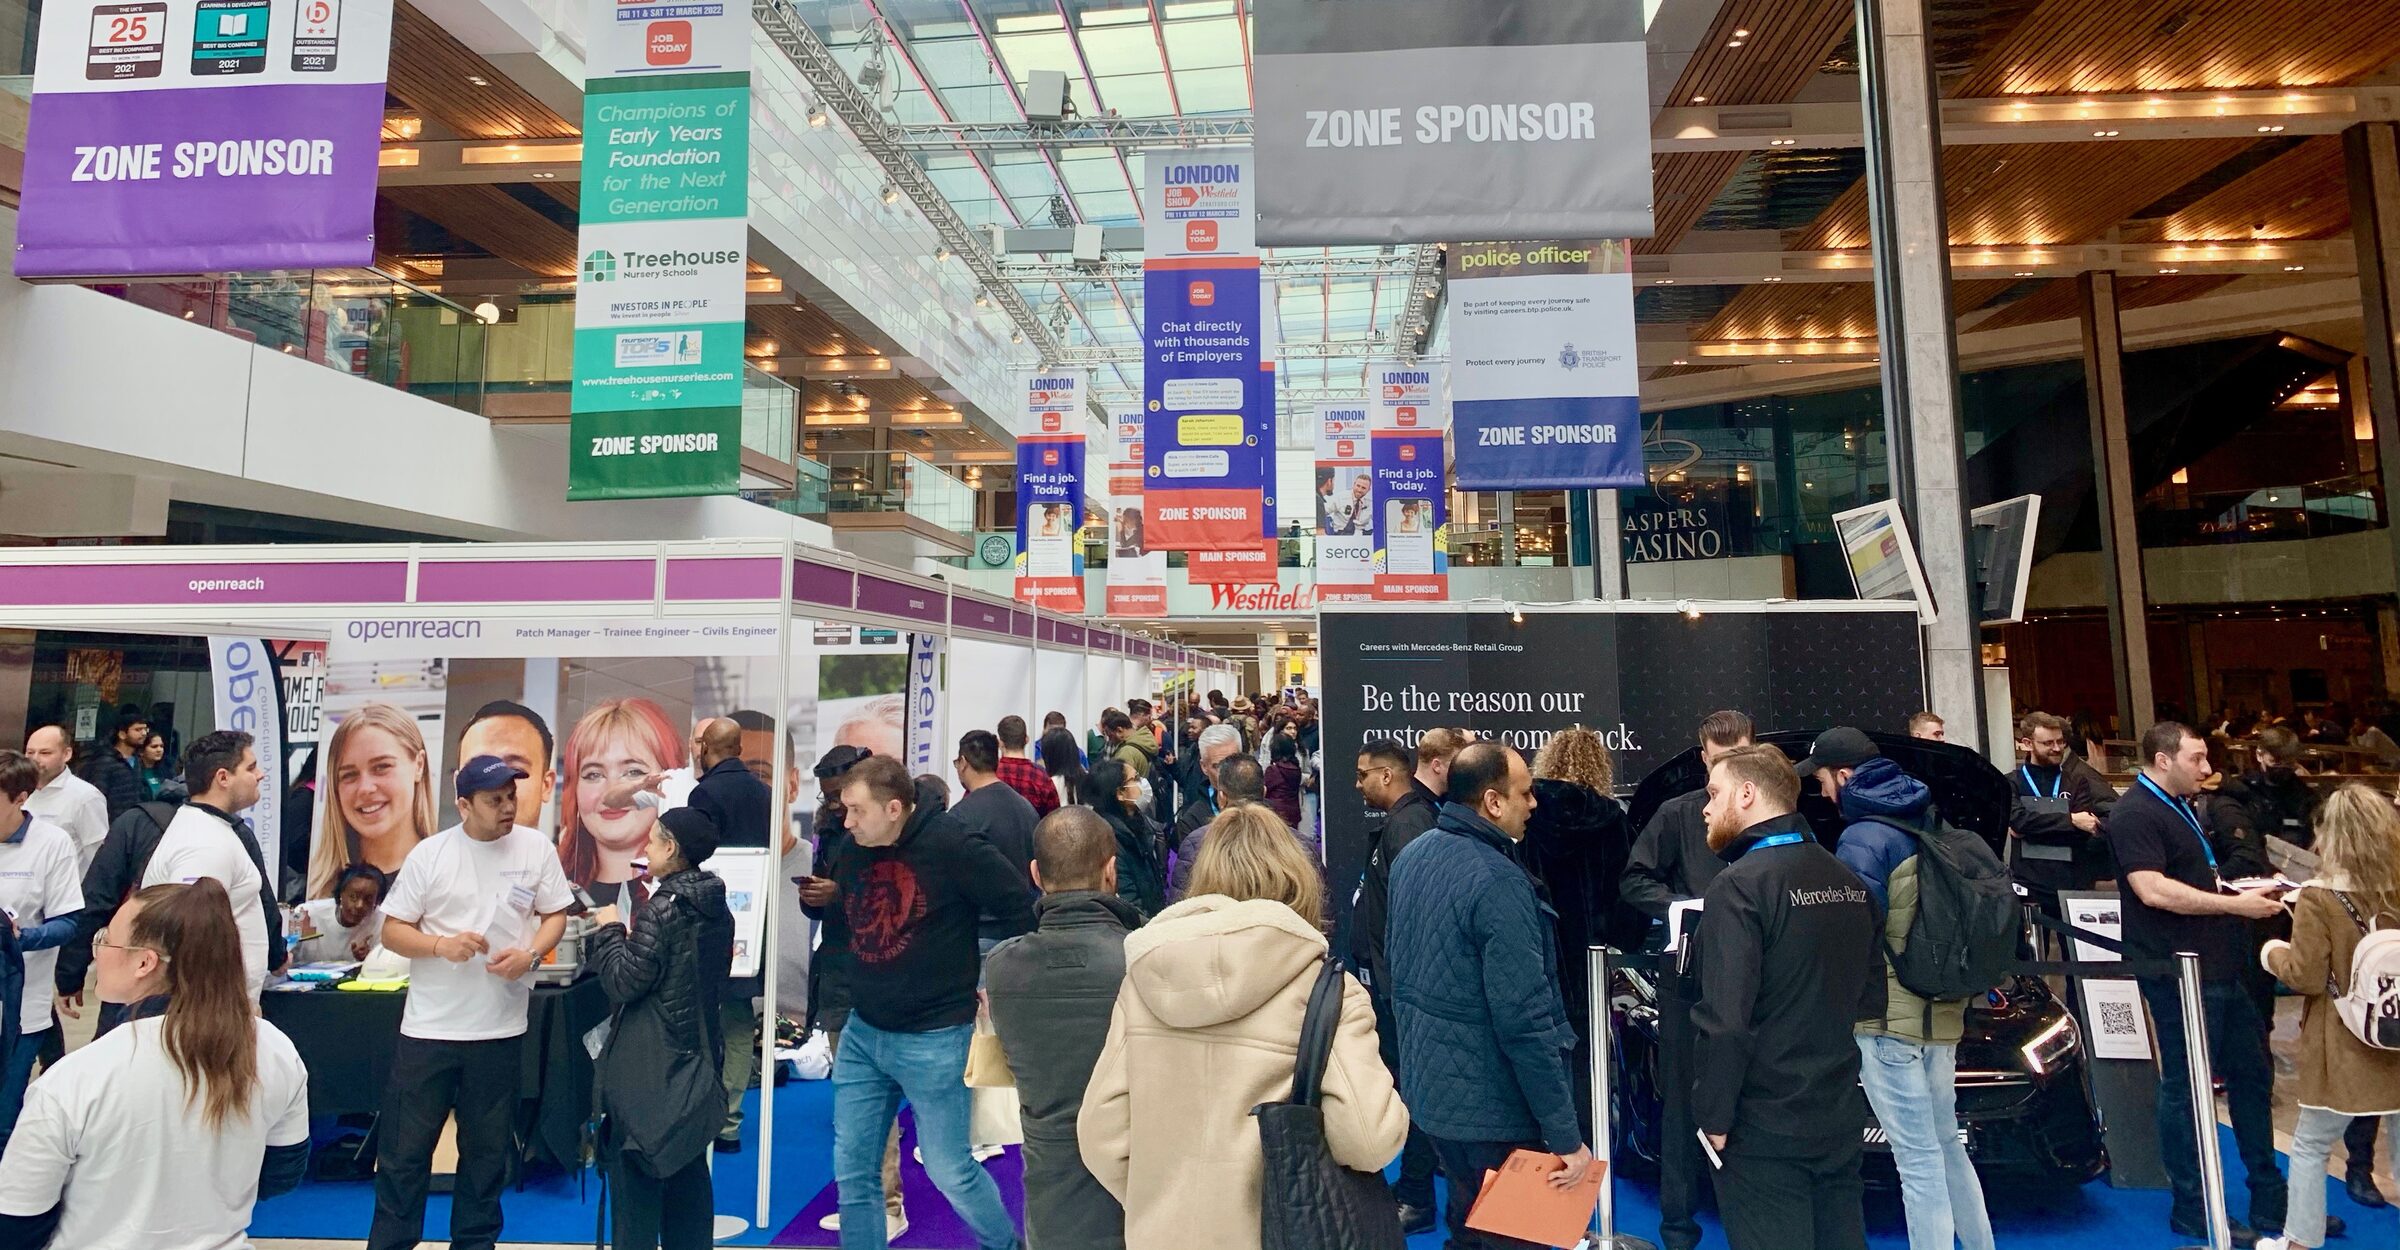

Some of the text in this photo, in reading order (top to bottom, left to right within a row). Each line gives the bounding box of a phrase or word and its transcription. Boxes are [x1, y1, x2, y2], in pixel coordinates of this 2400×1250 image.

[632, 10, 640, 18] 11
[650, 8, 664, 17] SAT
[666, 8, 674, 16] 12
[676, 7, 702, 16] MARCH
[704, 6, 722, 14] 2022
[109, 17, 147, 42] 25
[652, 34, 673, 43] JOB
[651, 44, 687, 53] TODAY
[218, 60, 240, 68] 2021
[303, 57, 326, 66] 2021
[114, 64, 136, 73] 2021
[598, 100, 738, 123] Champions of
[1305, 102, 1595, 148] ZONE SPONSOR
[608, 126, 722, 147] Early Years
[72, 140, 334, 182] ZONE SPONSOR
[608, 149, 720, 168] Foundation
[1165, 164, 1239, 185] LONDON
[602, 170, 727, 192] for the Next
[1166, 185, 1238, 199] JOB Westfield
[608, 196, 718, 215] Generation
[1166, 198, 1191, 207] SHOW
[624, 250, 740, 268] Treehouse
[1461, 246, 1591, 272] police officer
[623, 269, 698, 279] Nursery Schools
[611, 300, 708, 312] INVESTORS IN PEOPLE
[1499, 299, 1526, 308] keeping
[1162, 321, 1242, 334] Chat directly
[1154, 336, 1250, 347] with thousands
[1161, 351, 1242, 364] of Employers
[1516, 357, 1546, 365] journey
[582, 372, 733, 386] www.treehousenurseries.com
[1383, 372, 1429, 384] LONDON
[1030, 379, 1074, 390] LONDON
[1325, 410, 1365, 421] LONDON
[1478, 424, 1616, 447] ZONE SPONSOR
[592, 433, 718, 456] ZONE SPONSOR
[1024, 474, 1046, 483] Find
[1058, 473, 1077, 484] job.
[1379, 469, 1403, 478] Find
[1416, 469, 1437, 481] job.
[1033, 485, 1068, 496] Today.
[1390, 481, 1426, 492] Today.
[1159, 508, 1247, 520] ZONE SPONSOR
[1200, 552, 1266, 562] MAIN SPONSOR
[1326, 546, 1369, 559] serco
[188, 578, 264, 593] openreach
[1024, 587, 1077, 596] MAN SPONSOR
[1384, 585, 1439, 593] MAIN SPONSOR
[1211, 584, 1314, 611] Westfield
[516, 626, 777, 639] Patch Manager Trainee Engineer Civils Engineer
[1360, 643, 1523, 653] Careers with Mercedes-Benz Retail Group
[1362, 684, 1584, 713] Be the reason our
[1789, 886, 1866, 906] Mercedes-Benz
